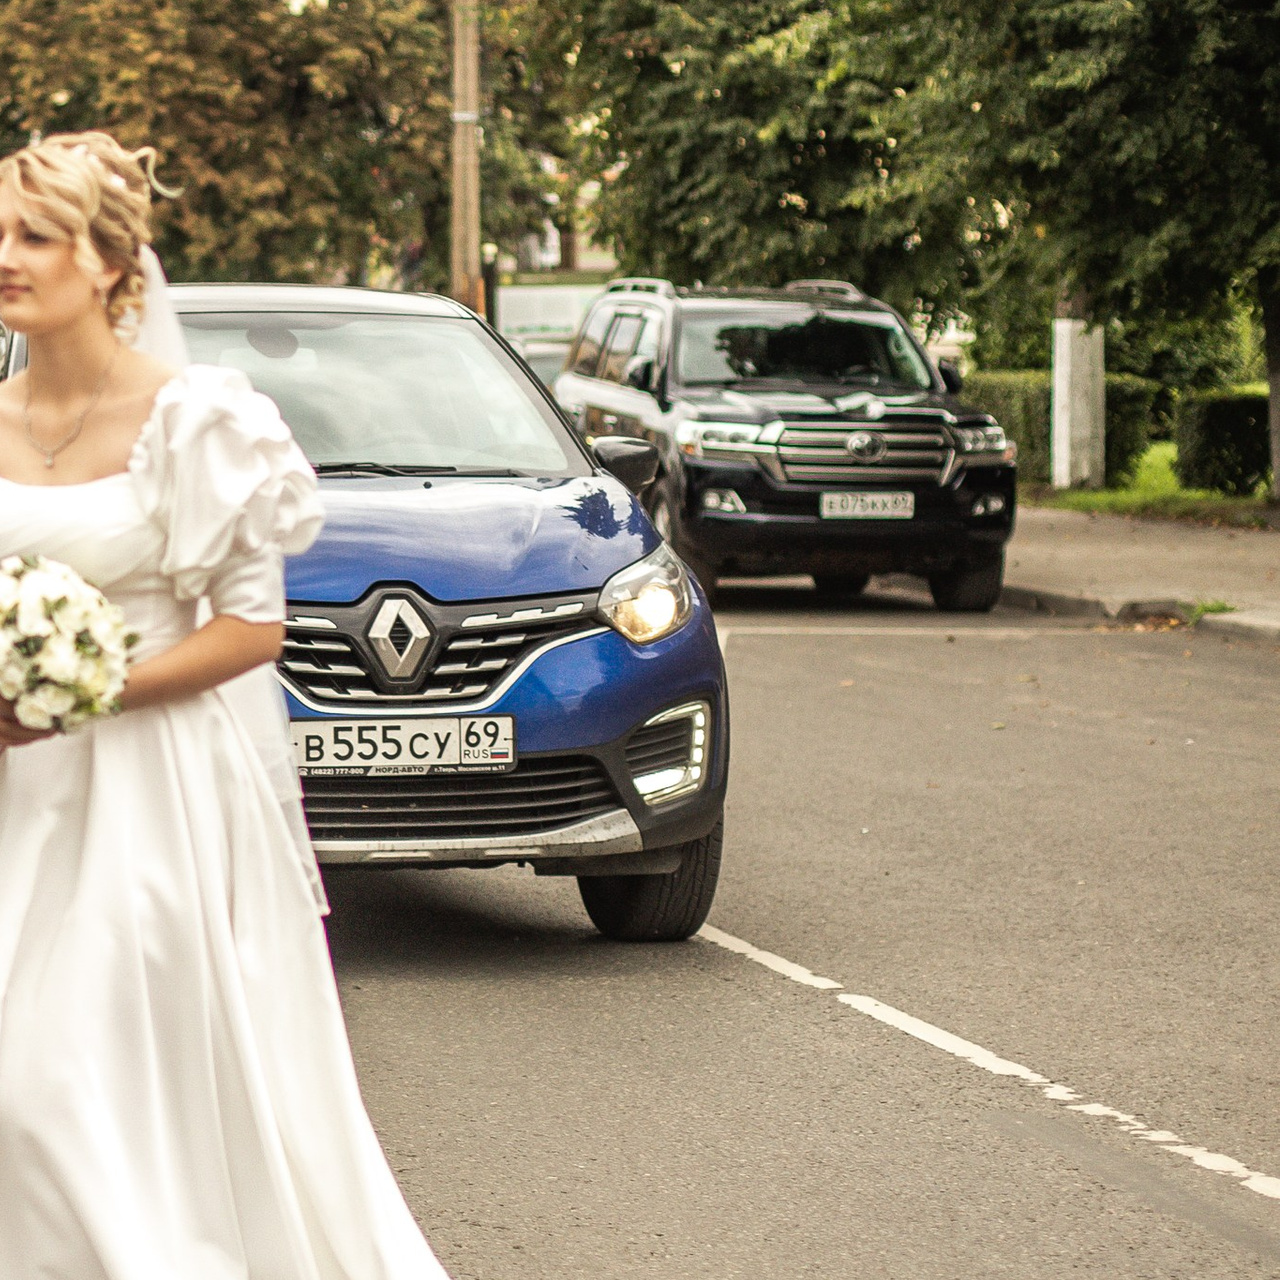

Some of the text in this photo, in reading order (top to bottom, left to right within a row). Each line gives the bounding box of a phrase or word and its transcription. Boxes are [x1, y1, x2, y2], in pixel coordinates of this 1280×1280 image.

[465, 720, 500, 748] 69
[463, 749, 489, 759] RUS
[375, 766, 424, 774] НОРД-АВТО
